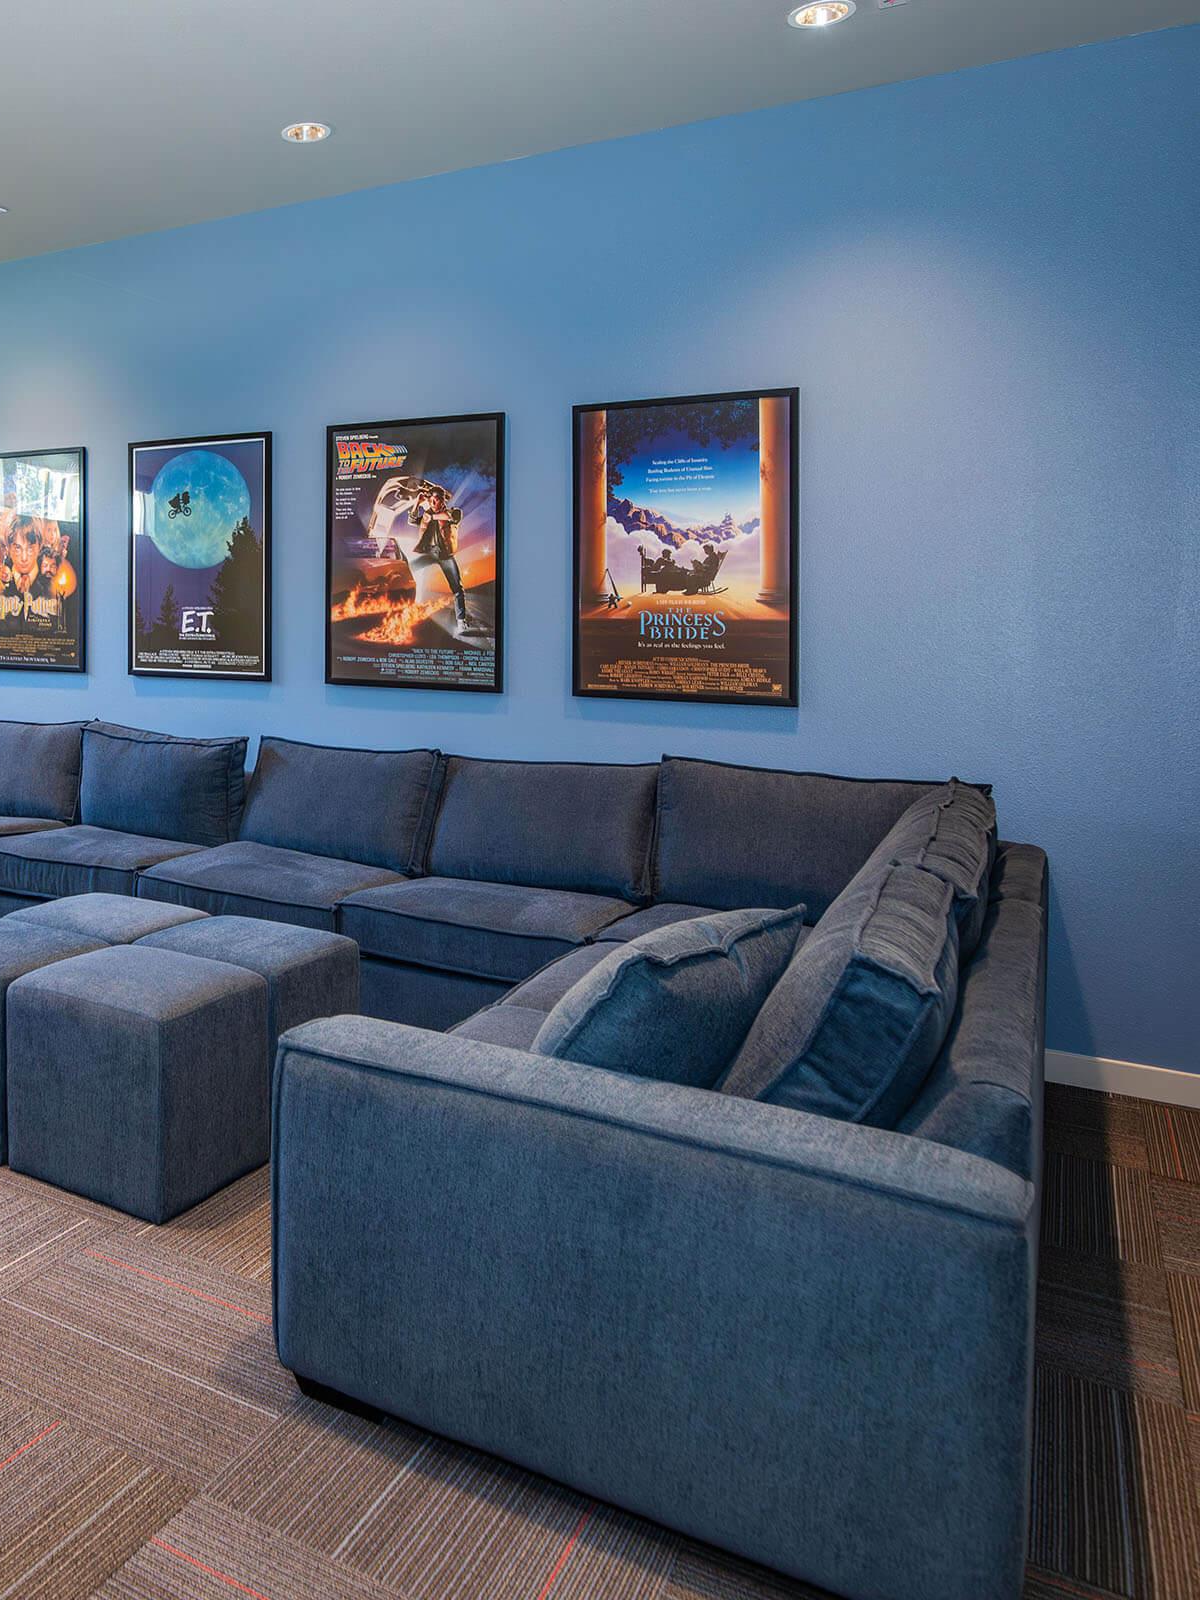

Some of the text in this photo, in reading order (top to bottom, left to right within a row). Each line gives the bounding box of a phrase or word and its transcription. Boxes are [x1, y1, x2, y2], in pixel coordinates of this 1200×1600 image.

[336, 441, 396, 459] BACK
[338, 456, 406, 474] TO FUTURE
[182, 610, 215, 633] E.T.
[637, 610, 726, 637] PRINCESS
[649, 626, 709, 640] BRIDE
[681, 642, 701, 650] feelings
